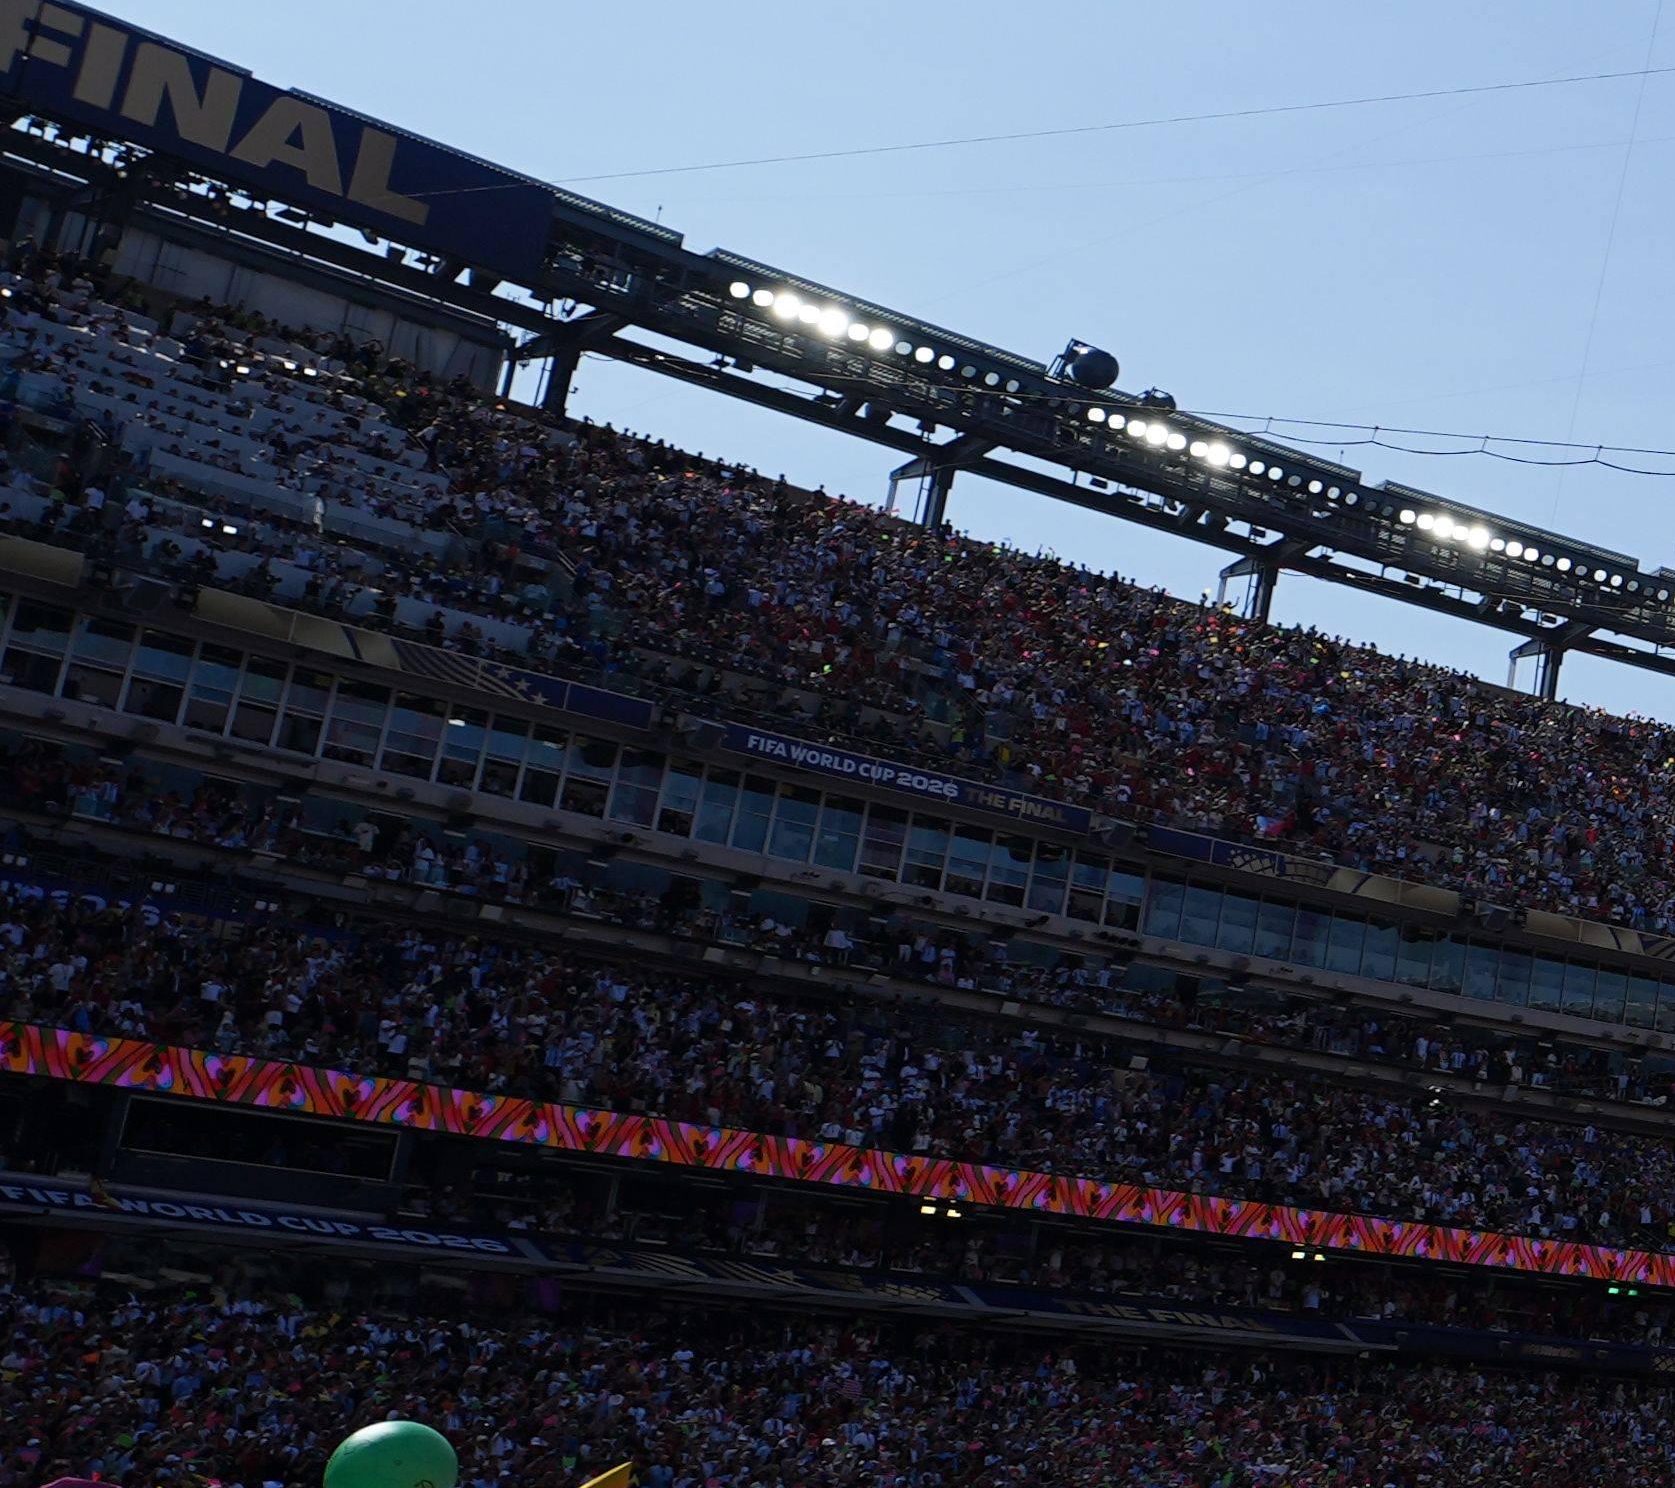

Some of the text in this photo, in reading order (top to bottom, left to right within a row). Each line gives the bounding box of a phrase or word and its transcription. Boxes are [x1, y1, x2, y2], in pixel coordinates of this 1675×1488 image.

[747, 735, 1069, 824] FIFA WORLD CUP 2026 THE FINAL
[3, 1185, 511, 1255] FIFA WORLD CUP 2026
